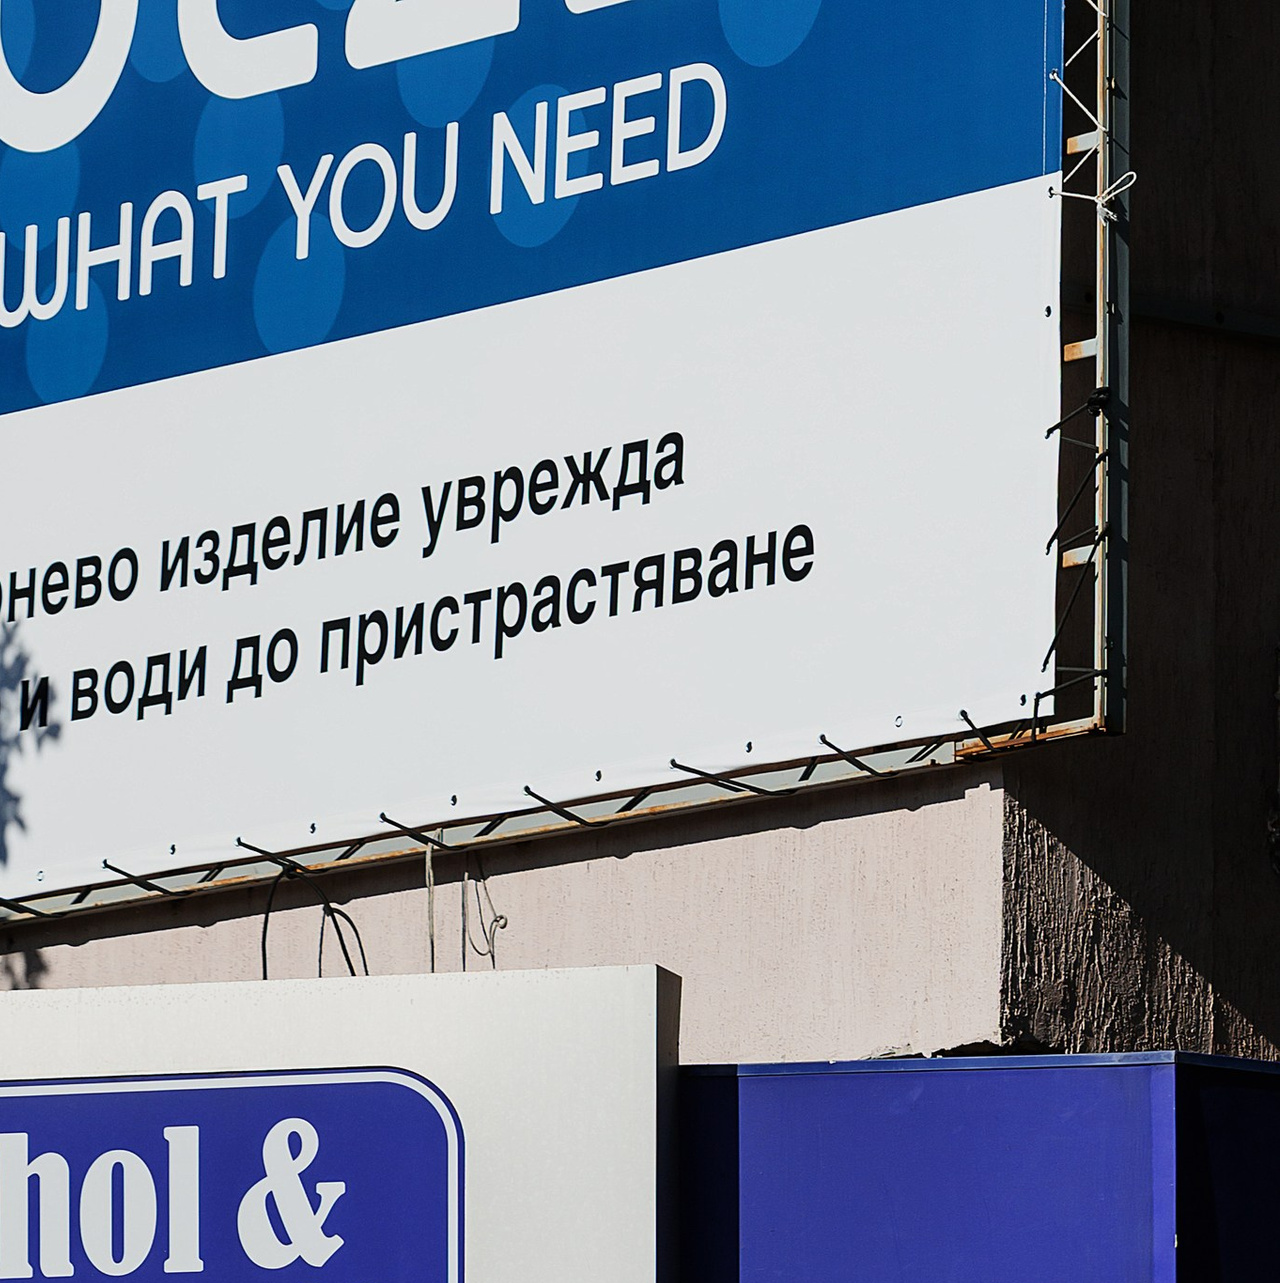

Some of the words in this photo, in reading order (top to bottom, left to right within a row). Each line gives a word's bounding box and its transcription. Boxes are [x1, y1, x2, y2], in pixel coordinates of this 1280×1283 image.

[277, 122, 459, 260] YOU
[490, 62, 727, 215] NEED
[160, 493, 400, 592] изделие
[421, 432, 685, 559] уврежда
[19, 676, 50, 732] и
[71, 646, 207, 721] води
[226, 628, 298, 704] до
[320, 524, 814, 687] пристрастяване
[237, 1117, 346, 1270] &
